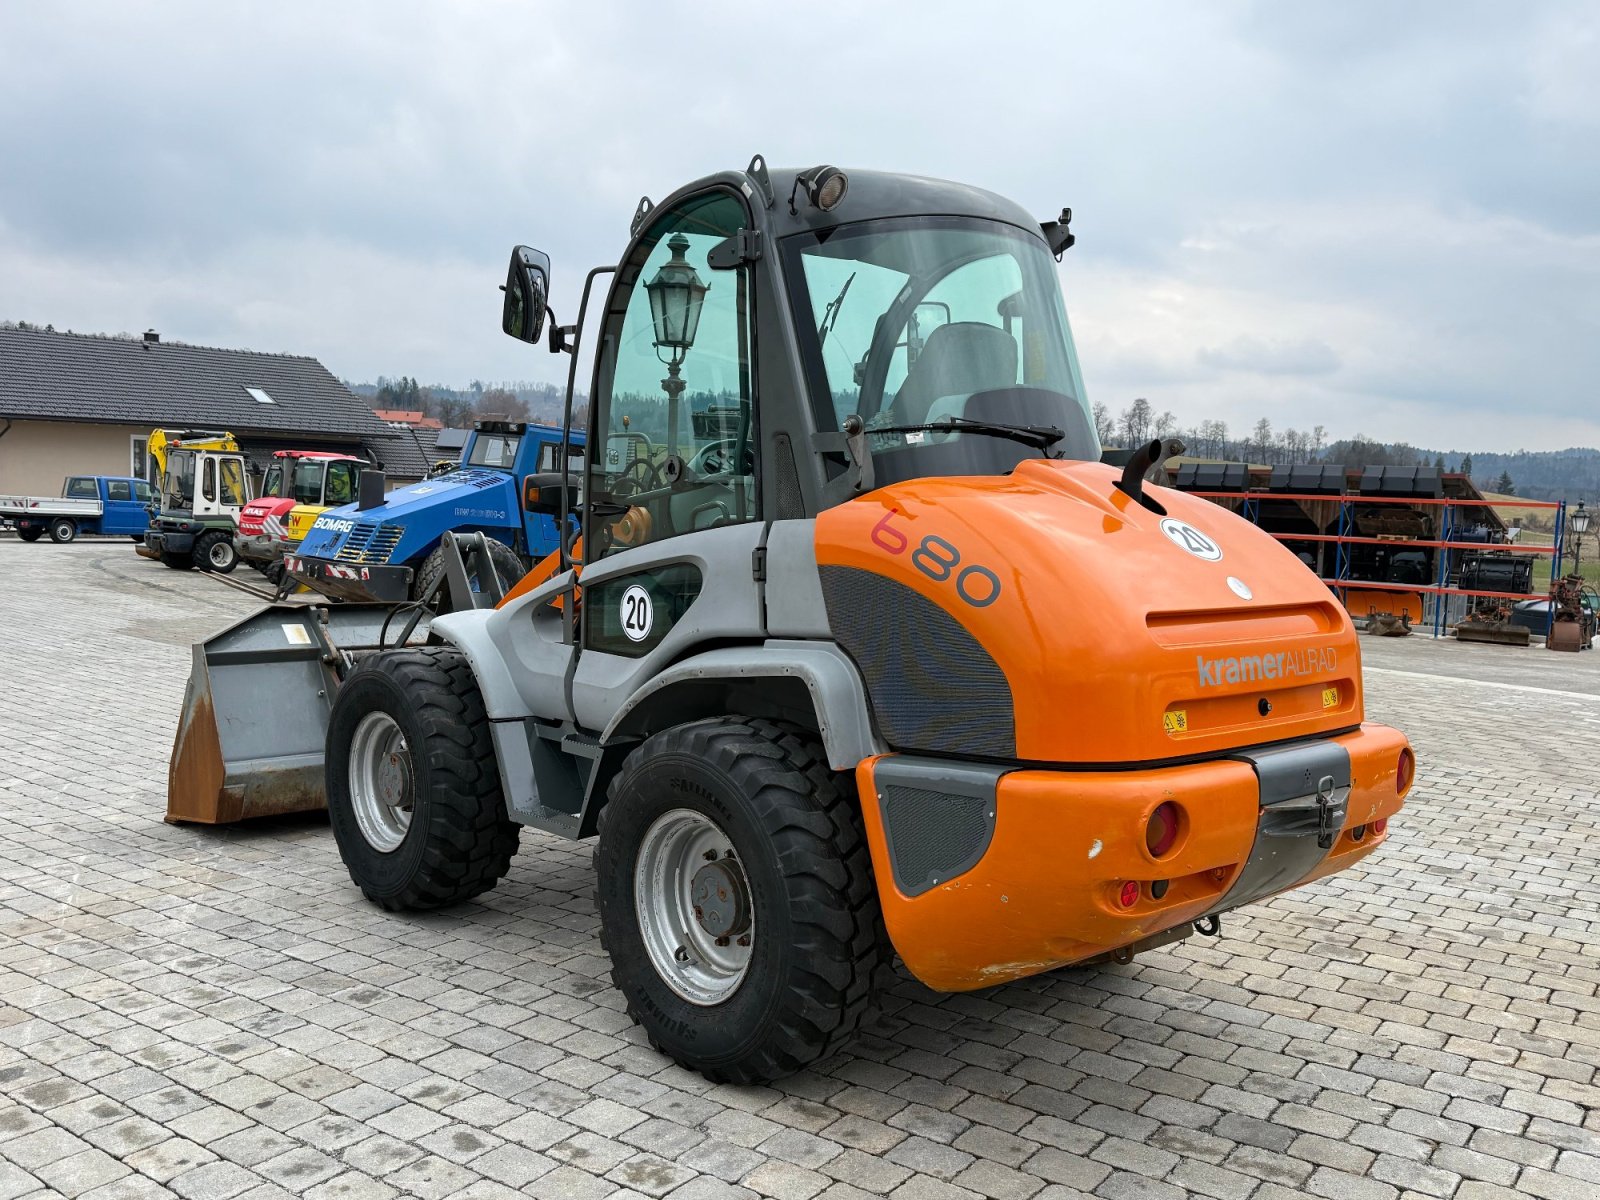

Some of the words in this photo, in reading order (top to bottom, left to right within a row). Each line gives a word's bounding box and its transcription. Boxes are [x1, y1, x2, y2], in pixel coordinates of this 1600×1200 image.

[313, 518, 354, 533] BOMAG
[1168, 526, 1214, 552] 20
[871, 508, 1001, 607] 680
[626, 595, 647, 631] 20
